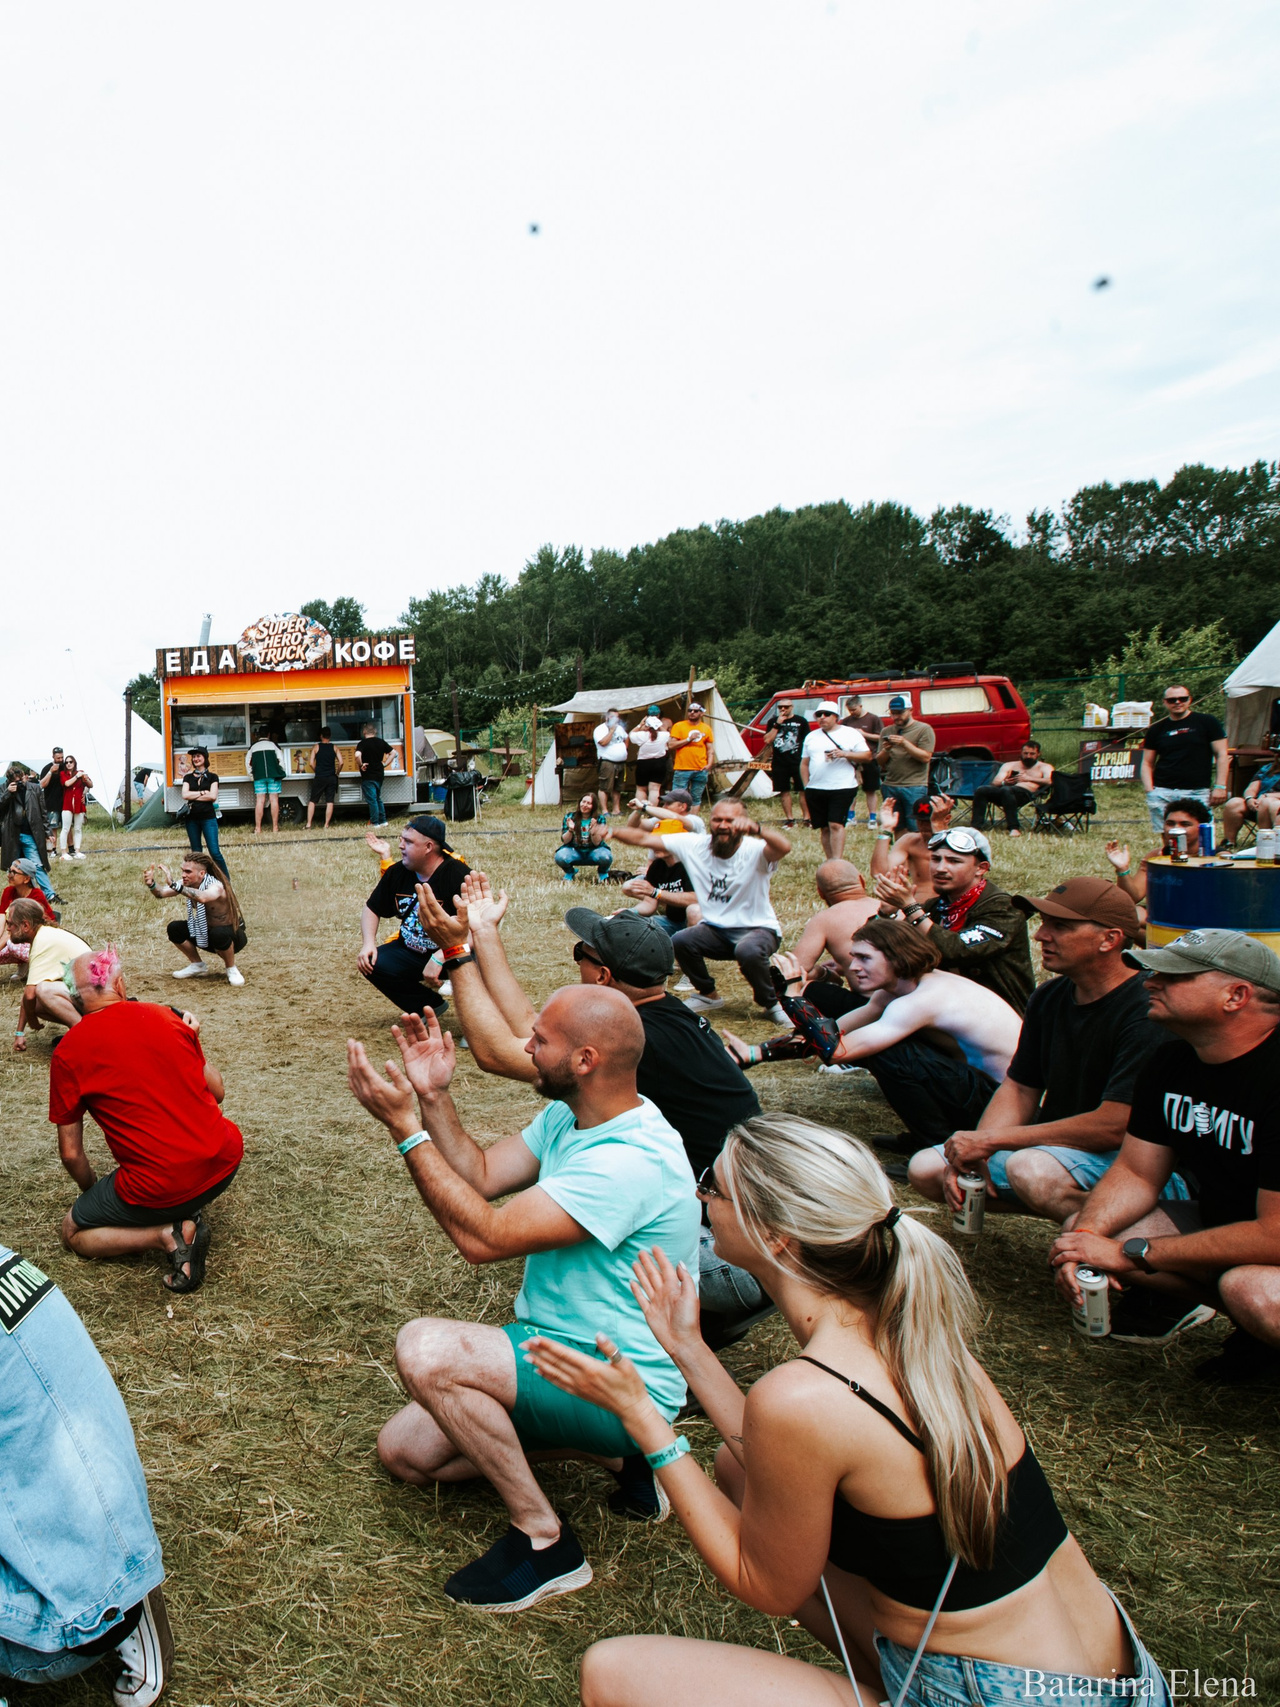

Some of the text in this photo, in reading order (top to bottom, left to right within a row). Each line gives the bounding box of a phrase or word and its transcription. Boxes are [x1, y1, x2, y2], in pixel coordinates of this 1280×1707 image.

[255, 617, 308, 640] SUPER
[263, 632, 304, 650] HERO
[334, 638, 416, 663] КОФЕ
[165, 649, 238, 675] ЕДА
[258, 643, 309, 665] TRUCK
[1093, 751, 1131, 766] ЗАРЯДИ
[1090, 765, 1135, 780] ТЕЛЕФОН!
